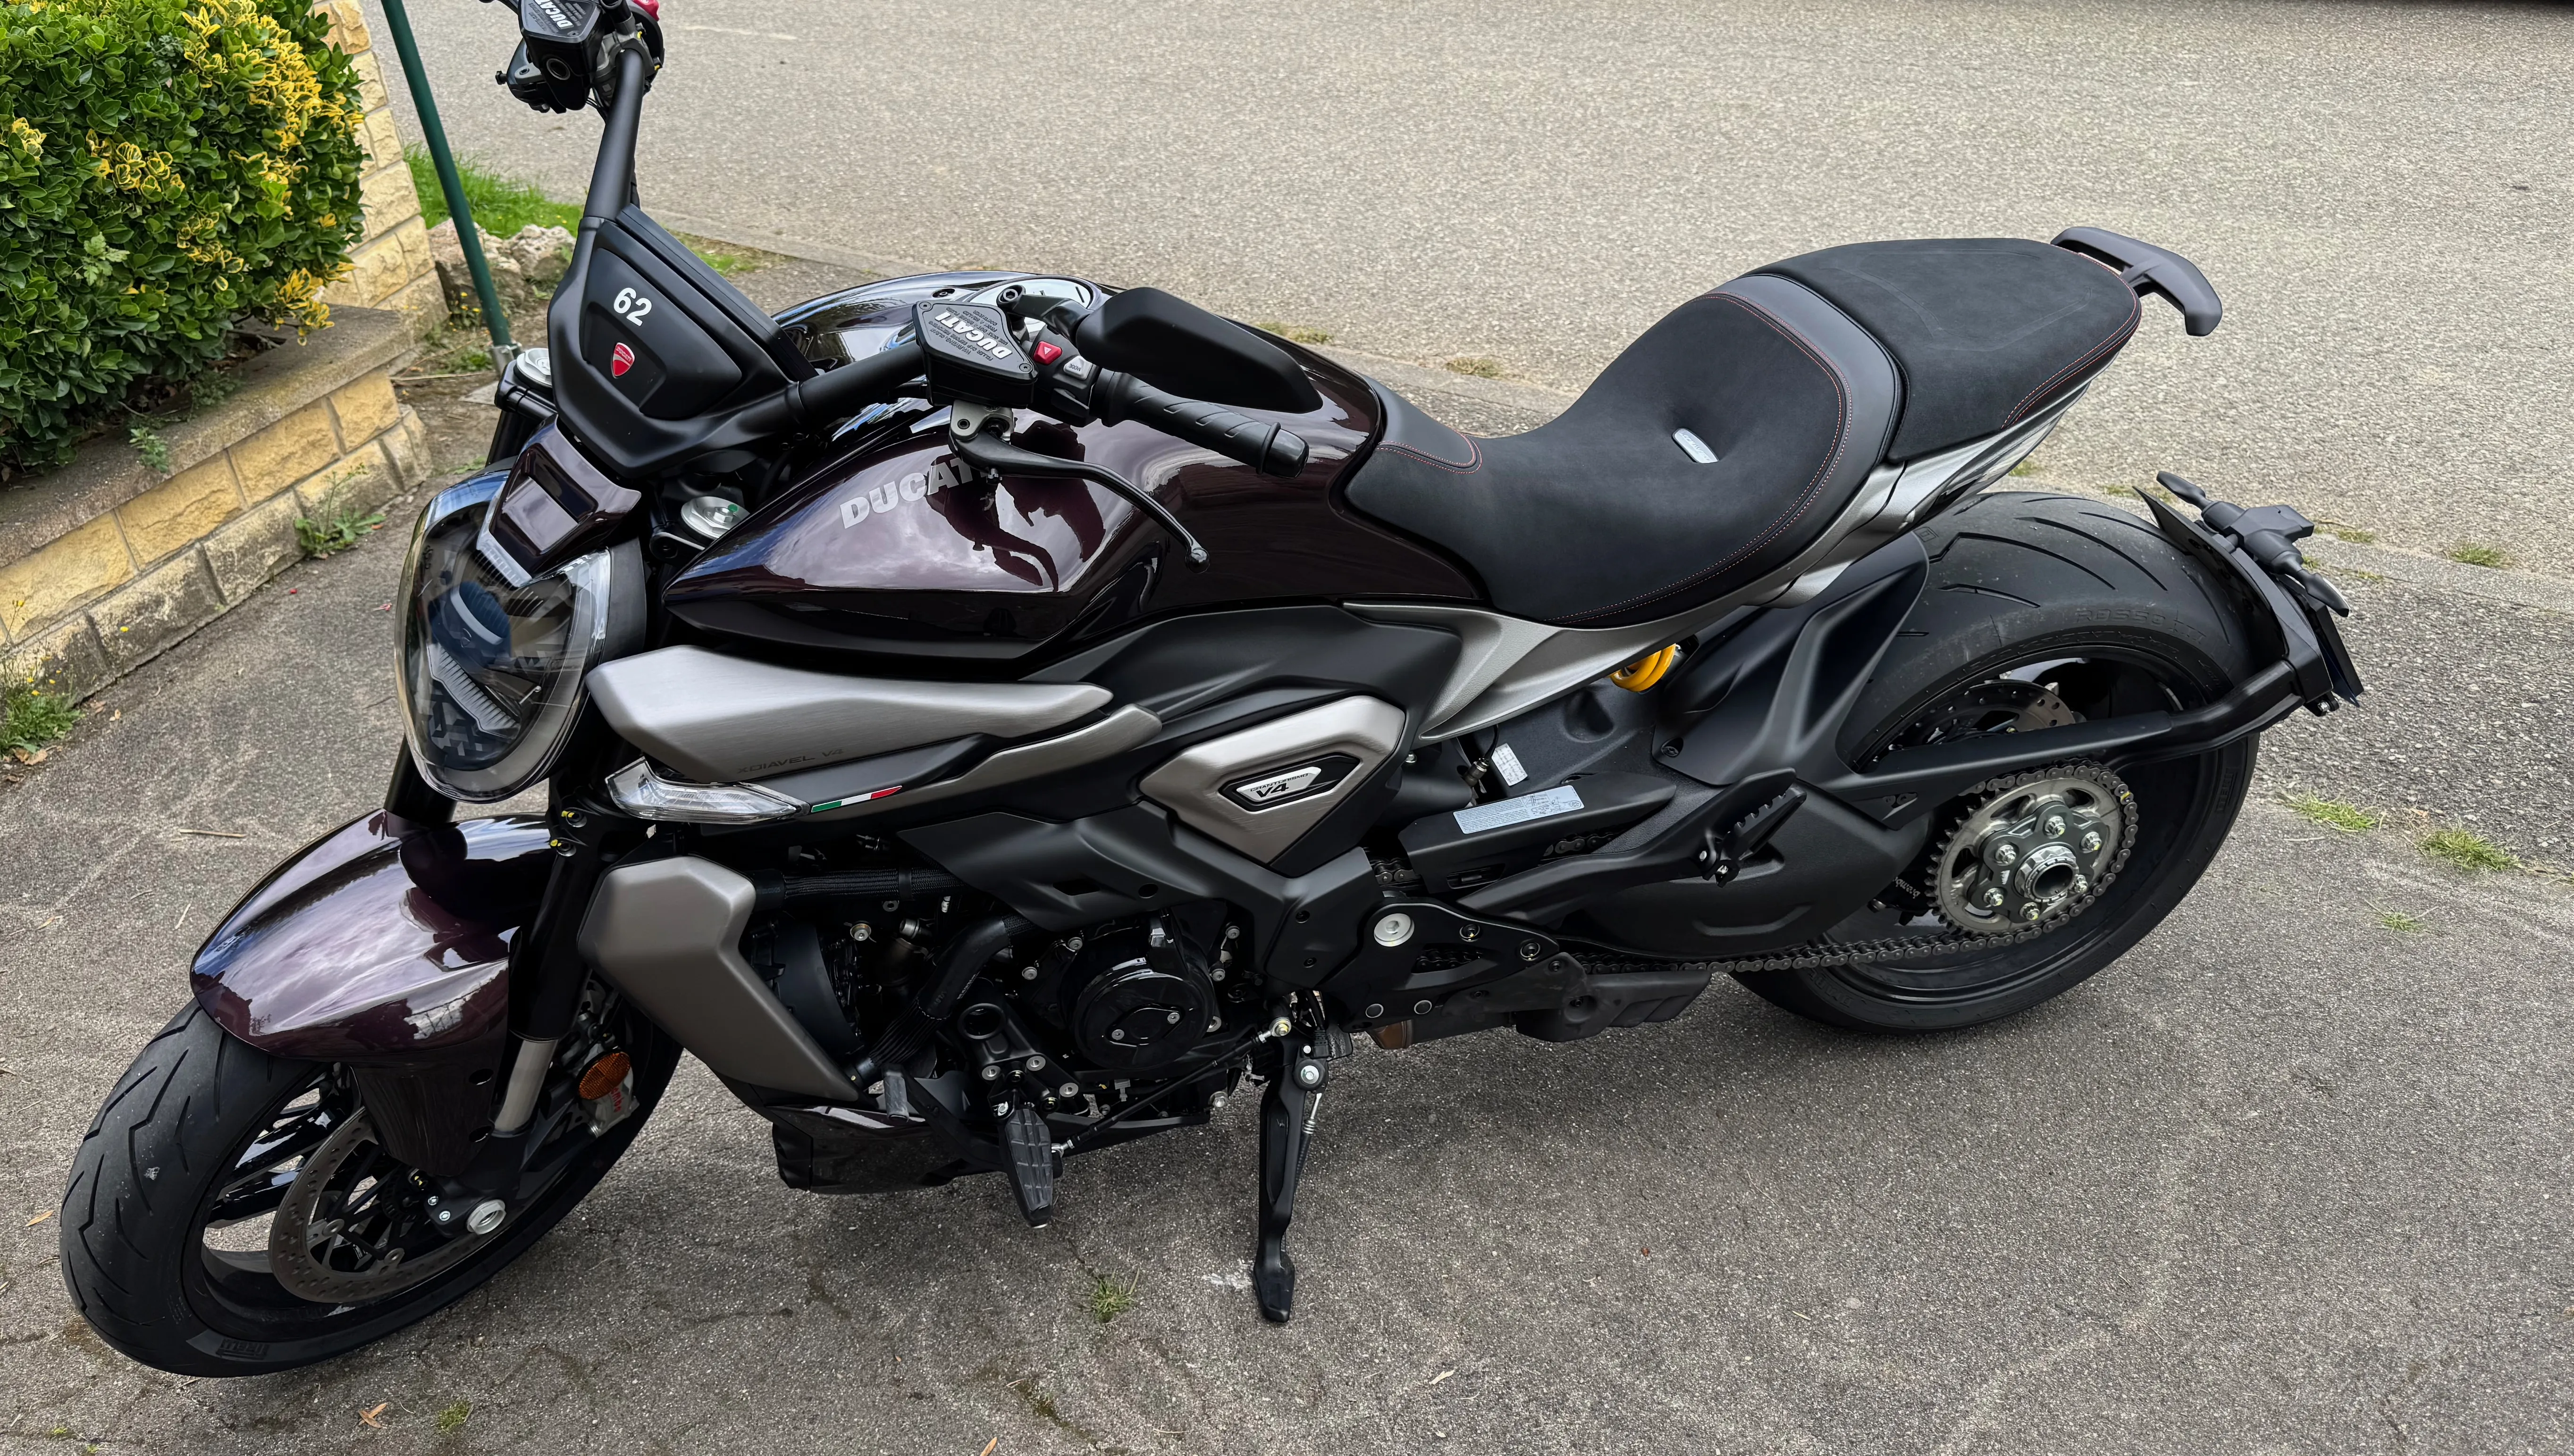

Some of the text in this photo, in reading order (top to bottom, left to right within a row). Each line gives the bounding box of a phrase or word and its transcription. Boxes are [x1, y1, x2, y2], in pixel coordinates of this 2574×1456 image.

[534, 0, 574, 29] DUCAT
[614, 287, 652, 326] 62
[934, 311, 1013, 359] DUCATI
[615, 347, 632, 362] DUCATI
[1069, 363, 1081, 372] MODE
[840, 457, 988, 529] DUCAT
[737, 749, 844, 774] XDIAVEL V4
[1256, 783, 1289, 797] V4
[1807, 967, 1854, 1009] DIABL
[611, 1087, 623, 1113] embo
